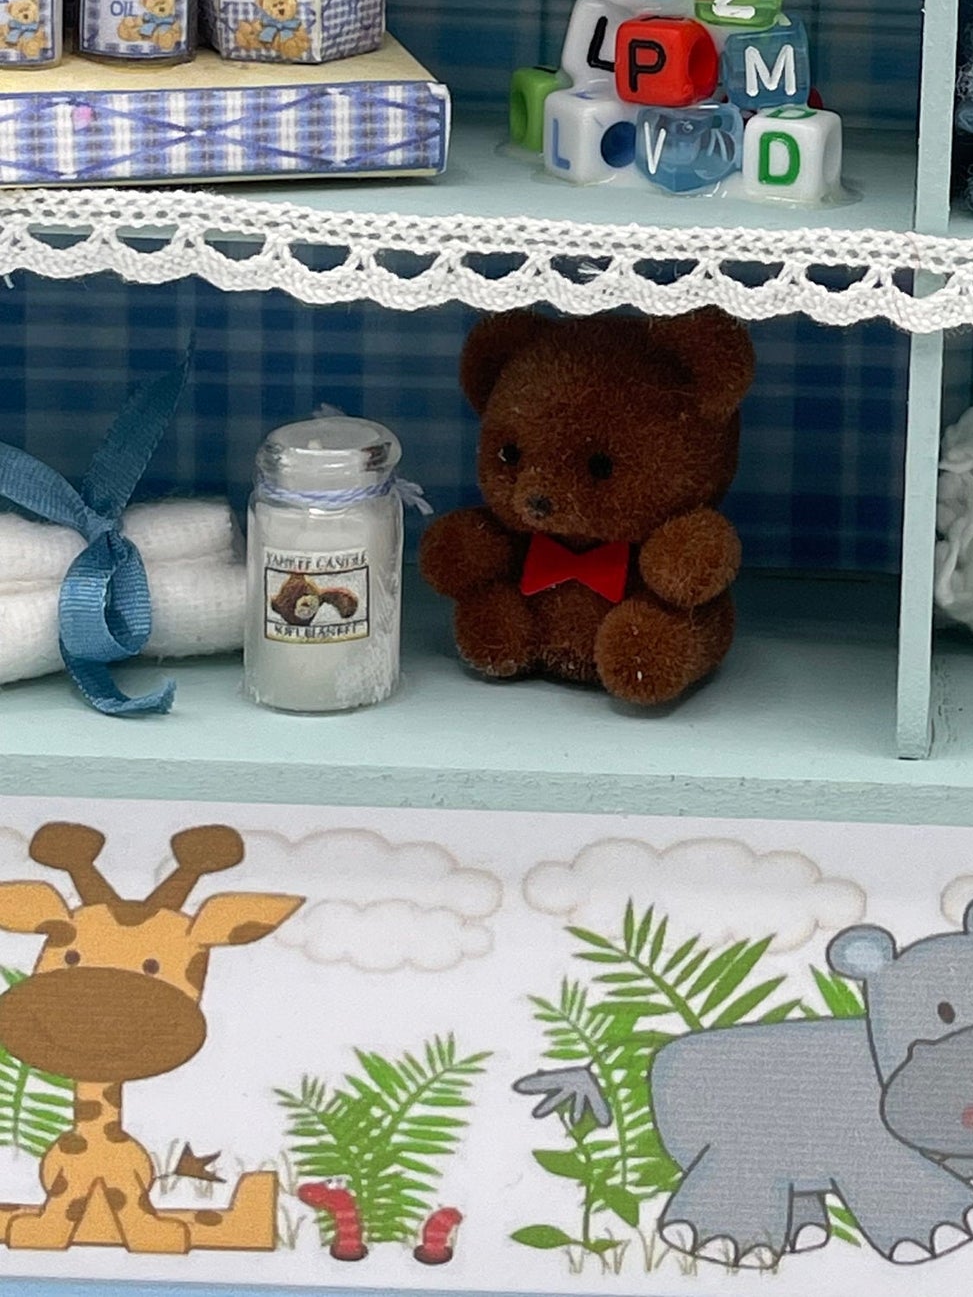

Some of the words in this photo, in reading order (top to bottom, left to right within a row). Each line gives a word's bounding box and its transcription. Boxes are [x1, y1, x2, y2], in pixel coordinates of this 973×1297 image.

[110, 0, 138, 17] OIL
[587, 15, 615, 72] L
[628, 38, 667, 93] P
[744, 44, 797, 96] M
[551, 117, 571, 171] L
[644, 121, 666, 175] V
[758, 132, 800, 185] D
